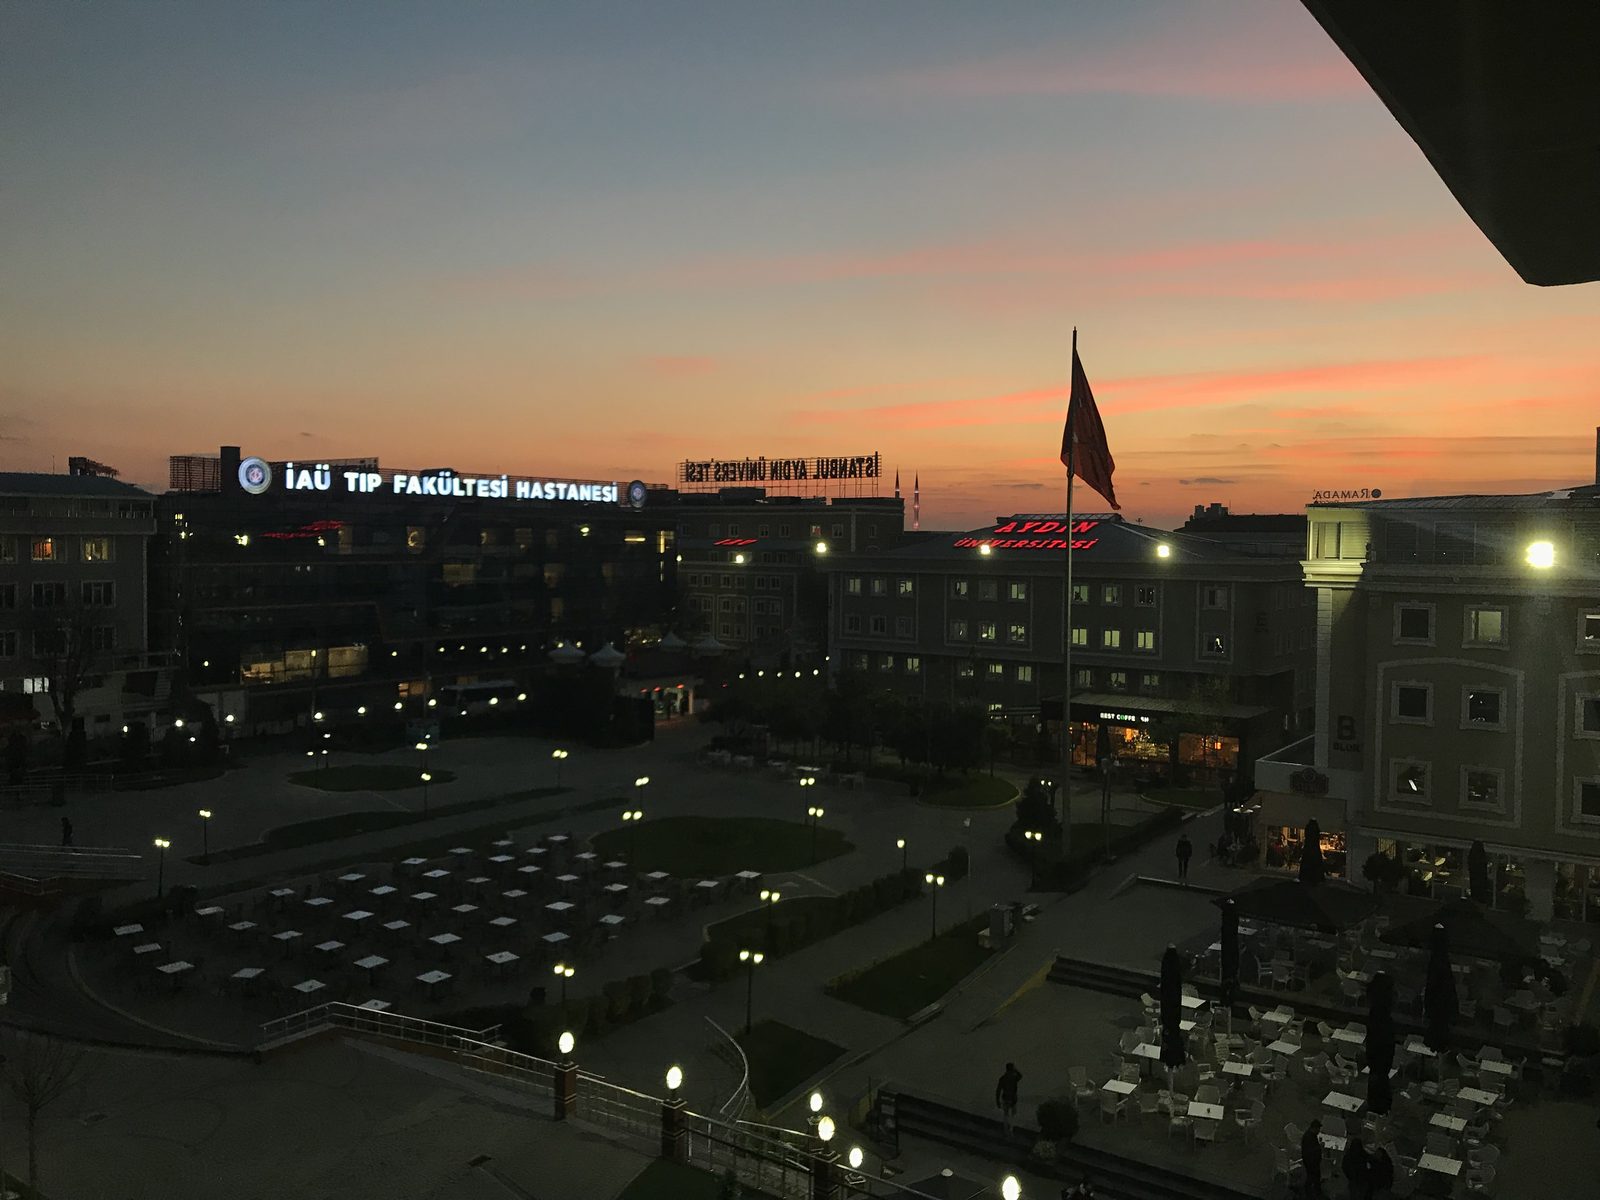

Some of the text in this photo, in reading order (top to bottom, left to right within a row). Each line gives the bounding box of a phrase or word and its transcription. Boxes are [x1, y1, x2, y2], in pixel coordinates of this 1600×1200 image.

[285, 462, 619, 503] İAÜ TIP FAKÜLTESİ HASTANESİ
[1099, 712, 1115, 720] BEST
[1337, 715, 1356, 740] B
[1333, 742, 1361, 752] BLOK
